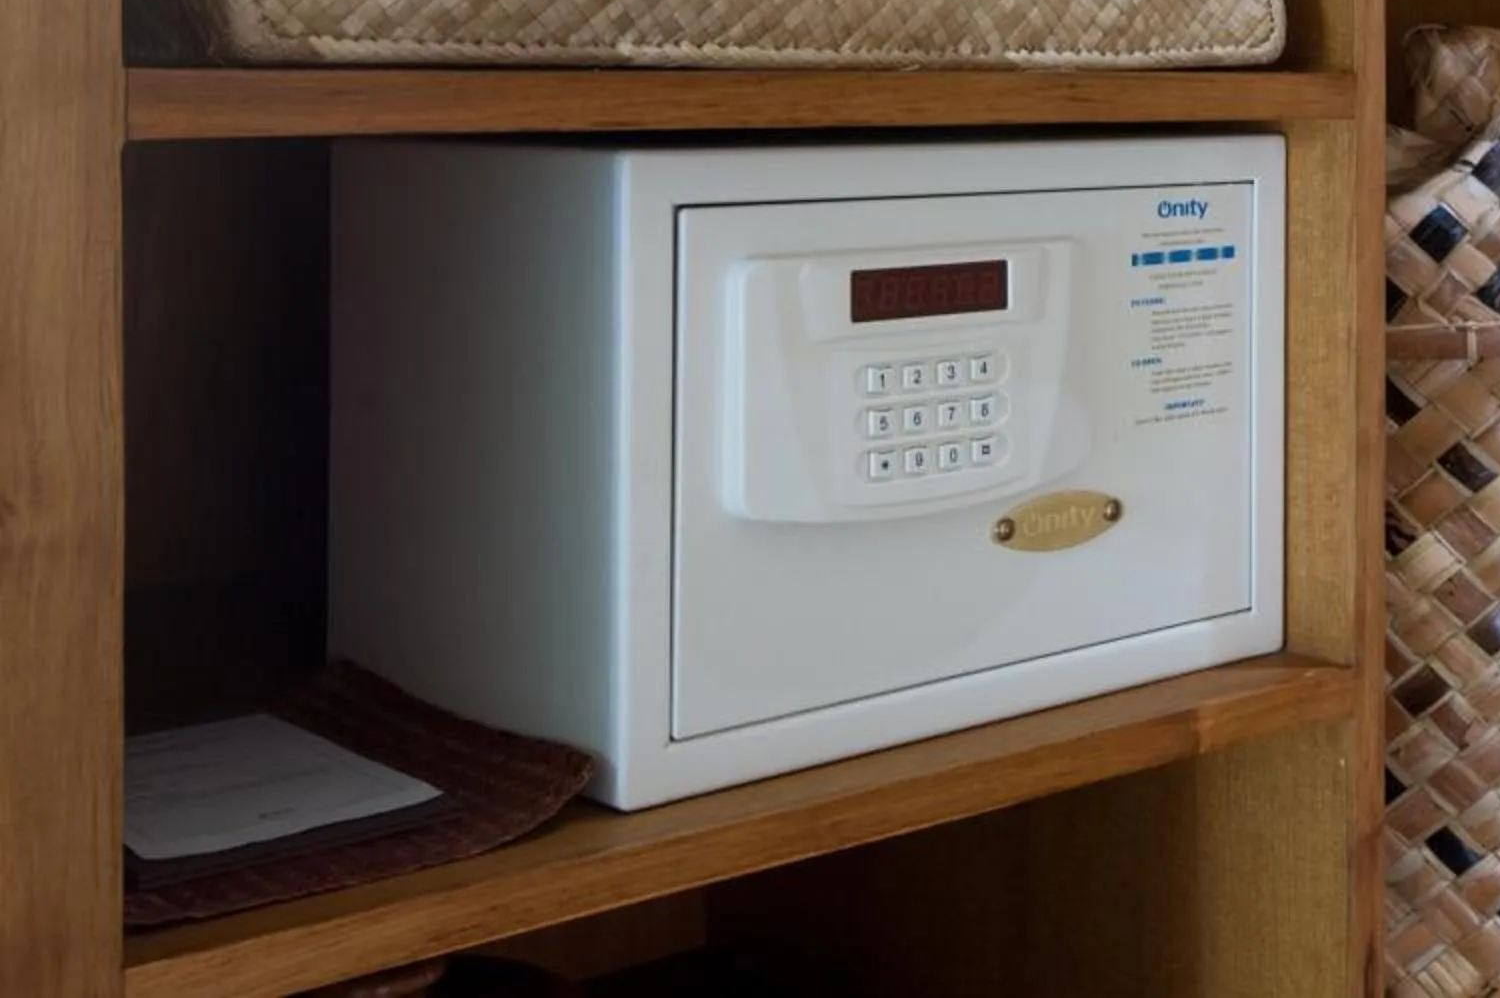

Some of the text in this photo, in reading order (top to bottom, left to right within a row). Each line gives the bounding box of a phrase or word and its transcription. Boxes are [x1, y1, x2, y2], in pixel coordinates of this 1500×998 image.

[1157, 198, 1208, 219] Onity
[913, 369, 922, 384] 2
[947, 365, 956, 380] 3
[980, 361, 988, 374] 4
[879, 415, 888, 430] 5
[913, 410, 922, 426] 6
[948, 406, 956, 421] 7
[915, 447, 958, 467] 9 0
[1022, 504, 1097, 536] Onity
